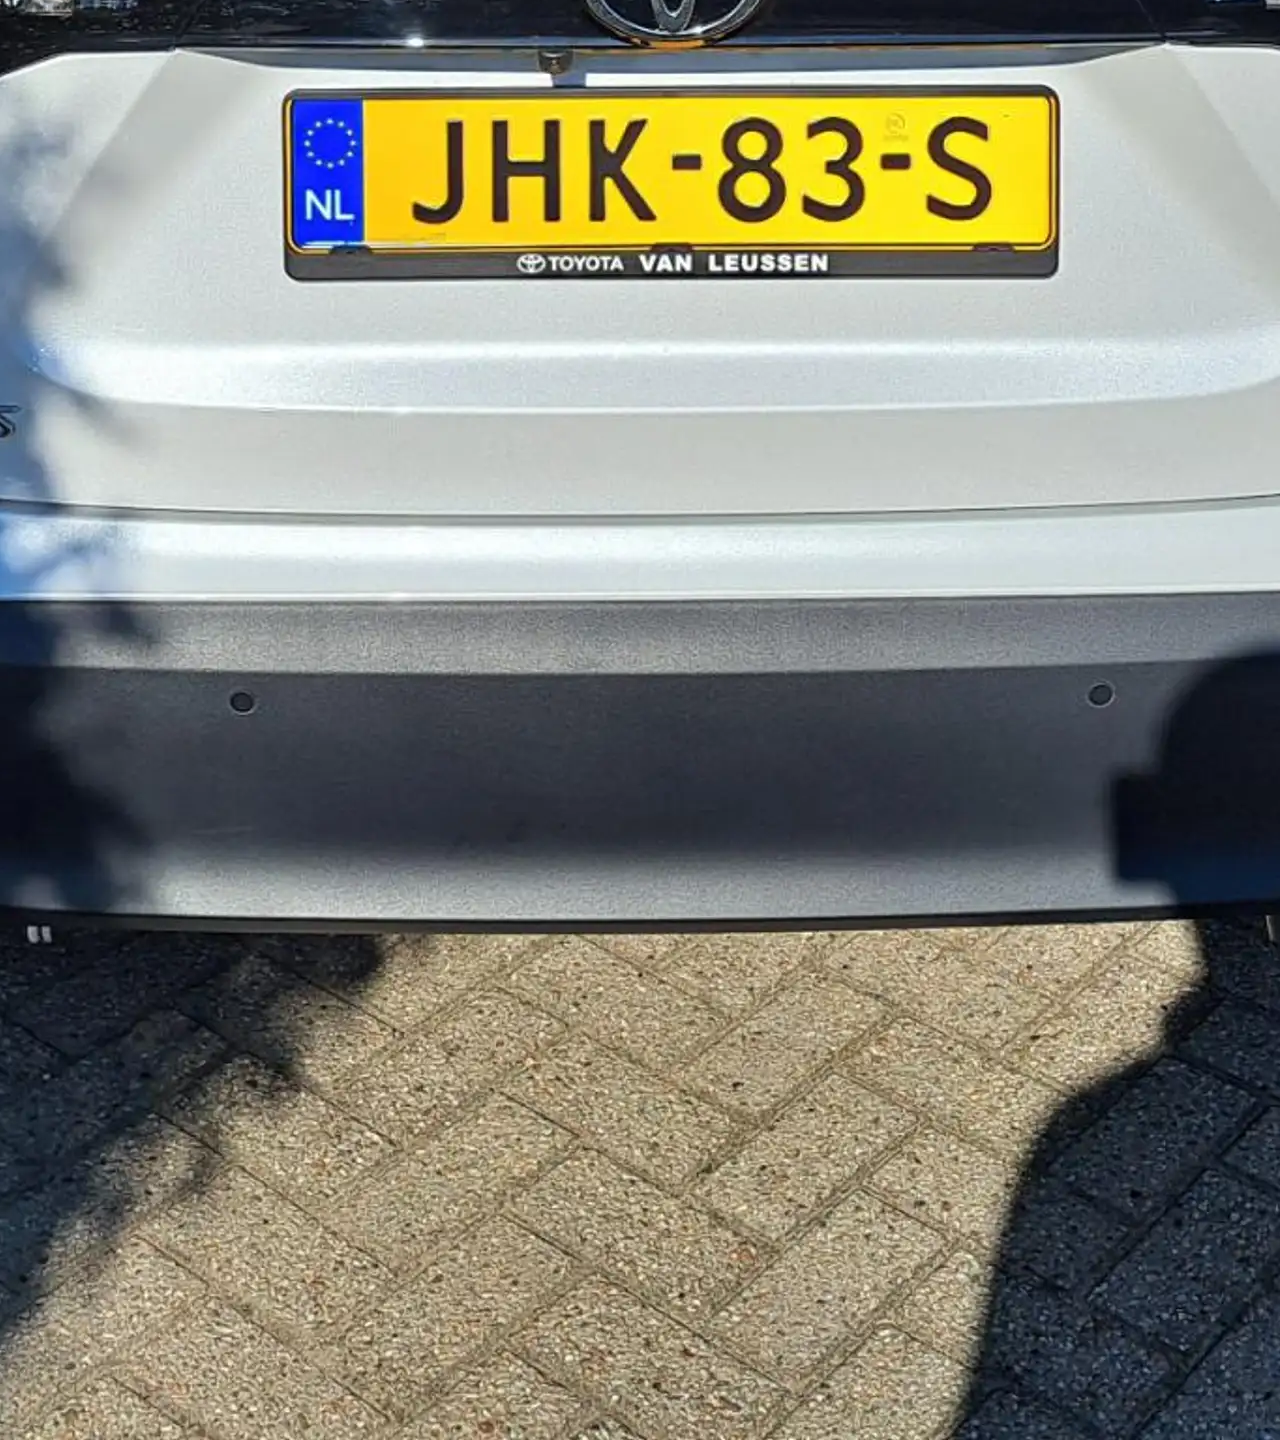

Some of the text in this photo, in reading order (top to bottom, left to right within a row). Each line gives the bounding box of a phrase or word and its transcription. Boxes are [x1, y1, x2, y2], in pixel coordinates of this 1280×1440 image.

[411, 116, 993, 224] JHK-83-S
[305, 189, 355, 221] NL
[548, 253, 829, 272] TOYOTA VAN LEUSSEN
